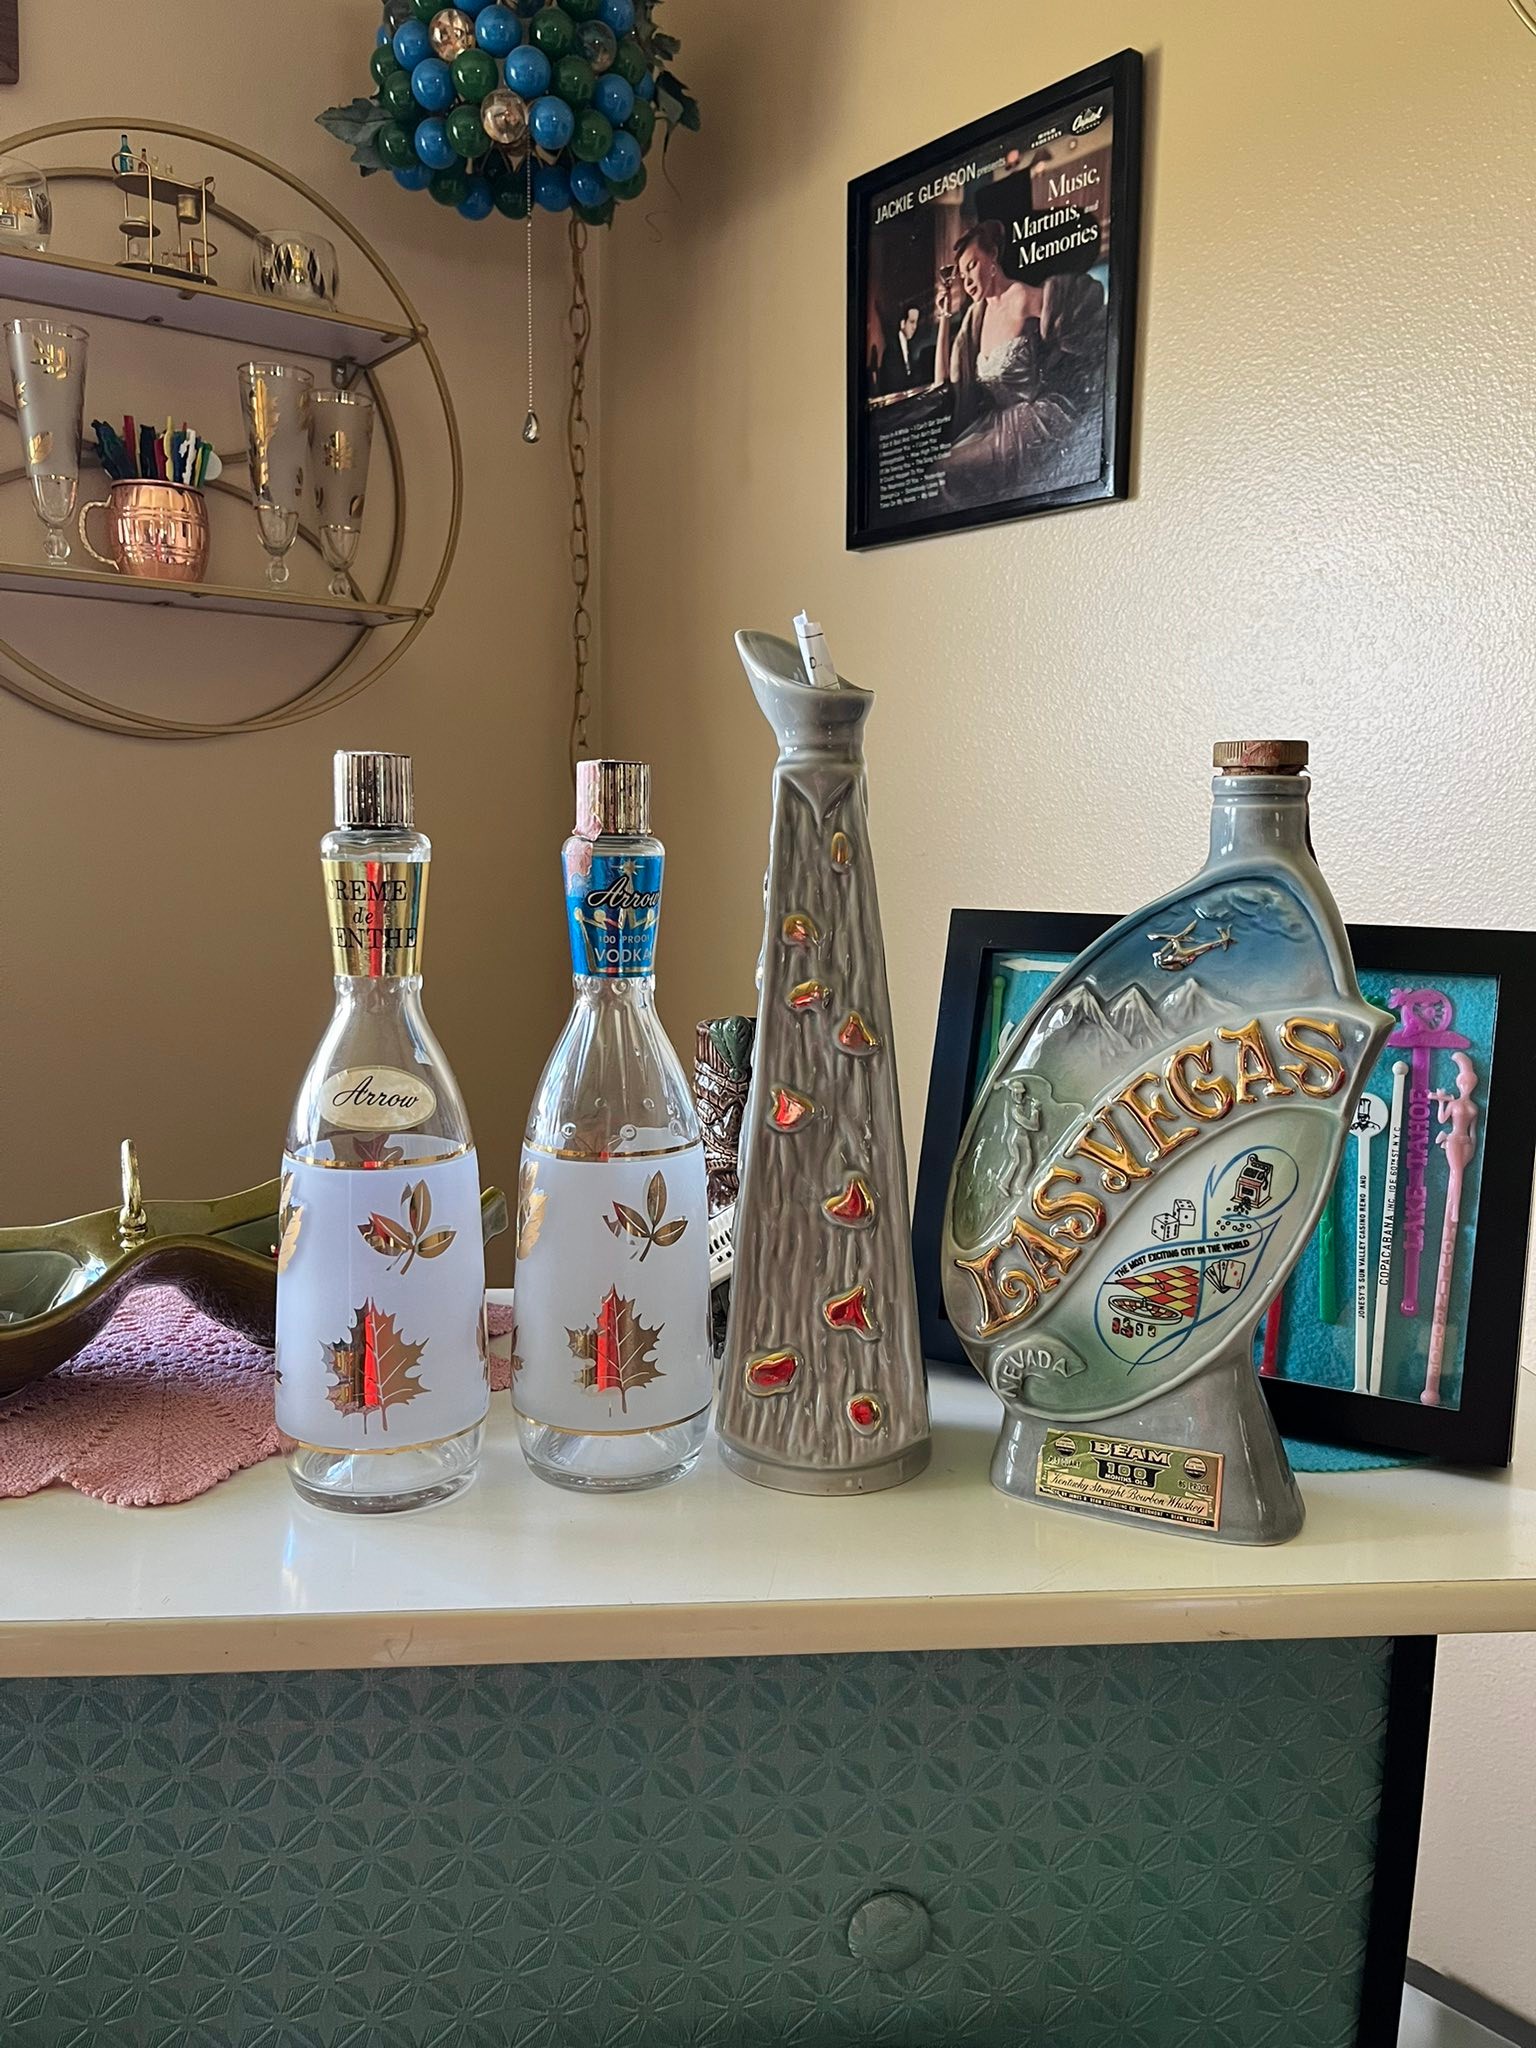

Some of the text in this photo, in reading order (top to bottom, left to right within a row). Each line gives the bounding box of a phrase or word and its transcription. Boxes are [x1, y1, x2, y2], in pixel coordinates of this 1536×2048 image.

[874, 191, 914, 225] JACKIE
[918, 162, 976, 204] GLEASON
[1047, 164, 1100, 202] Music,
[1012, 200, 1080, 244] Martinis,
[1018, 224, 1099, 269] Memories
[352, 907, 374, 924] de
[331, 927, 418, 949] ENTHE
[594, 947, 652, 963] VODKA
[332, 1075, 419, 1108] Arrow
[954, 1016, 1346, 1338] LAS VEGAS
[1403, 1089, 1431, 1251] LAKE TAHOE
[1114, 1239, 1251, 1279] THE MOST EXCITING CITY IN THE WORLD
[1358, 1175, 1367, 1319] JONESY'S SUN VALLEY CASINO RENO AND
[1379, 1215, 1394, 1286] COPACABANA
[1093, 1442, 1169, 1464] BEAM
[1106, 1462, 1147, 1480] 100
[1050, 1472, 1089, 1492] Kentucky
[1089, 1480, 1126, 1500] Straight
[1127, 1488, 1165, 1506] Bourbon
[1167, 1495, 1205, 1514] Whiskey
[1104, 1473, 1132, 1483] MONTHS
